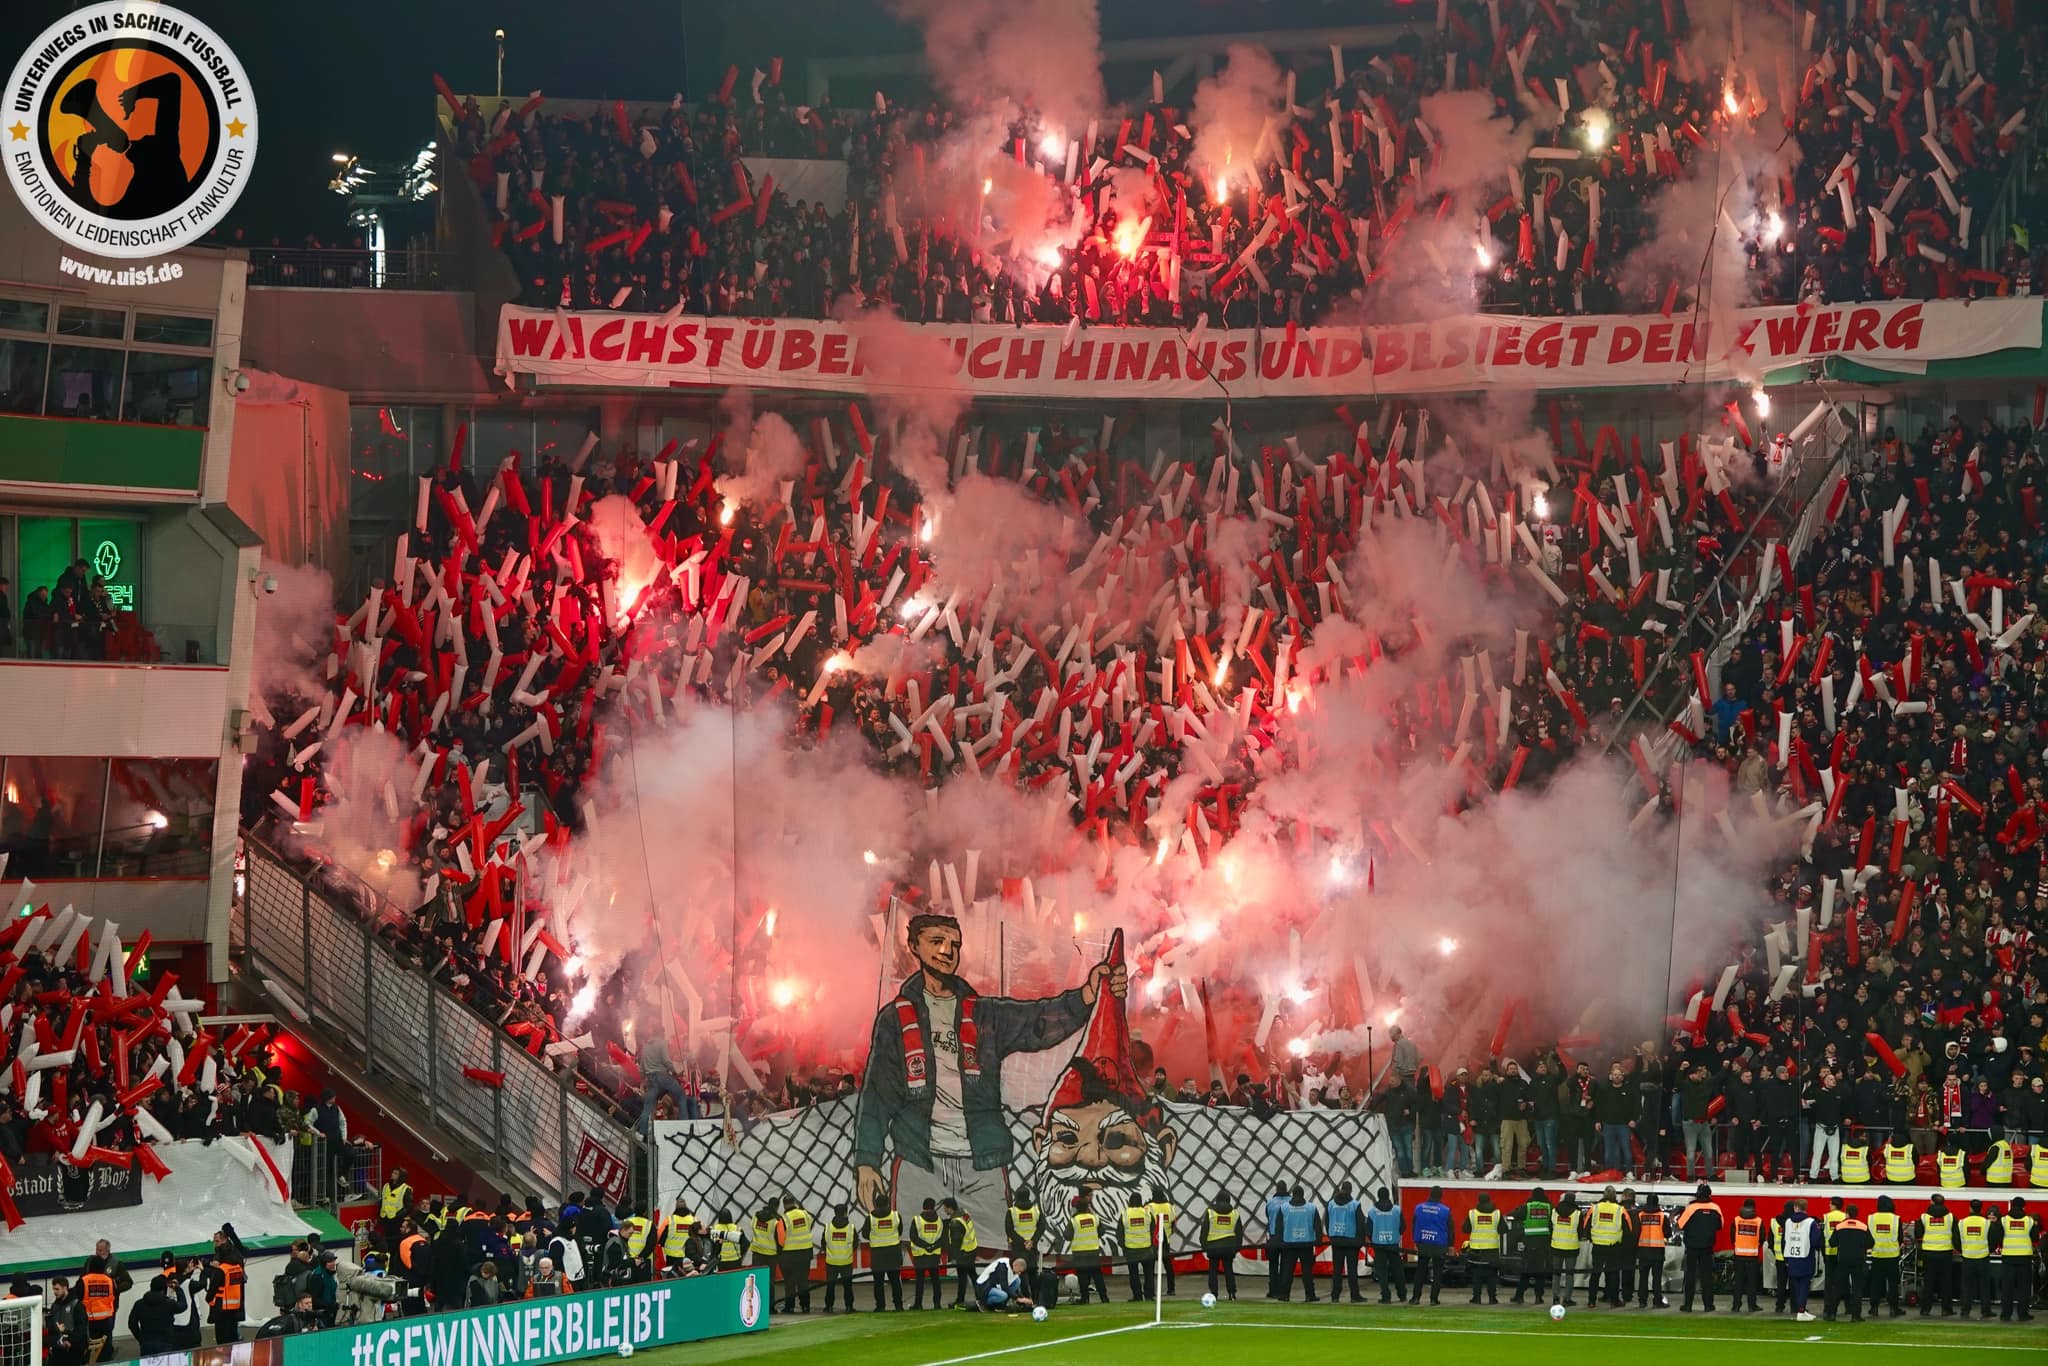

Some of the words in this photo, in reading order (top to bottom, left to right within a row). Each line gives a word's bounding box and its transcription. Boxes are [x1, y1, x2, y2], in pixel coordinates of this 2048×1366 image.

[508, 316, 735, 368] WACHST
[1053, 339, 1248, 382] HINAUS
[1260, 337, 1364, 381] UND
[351, 1289, 672, 1366] #GEWINNERBLEIBT
